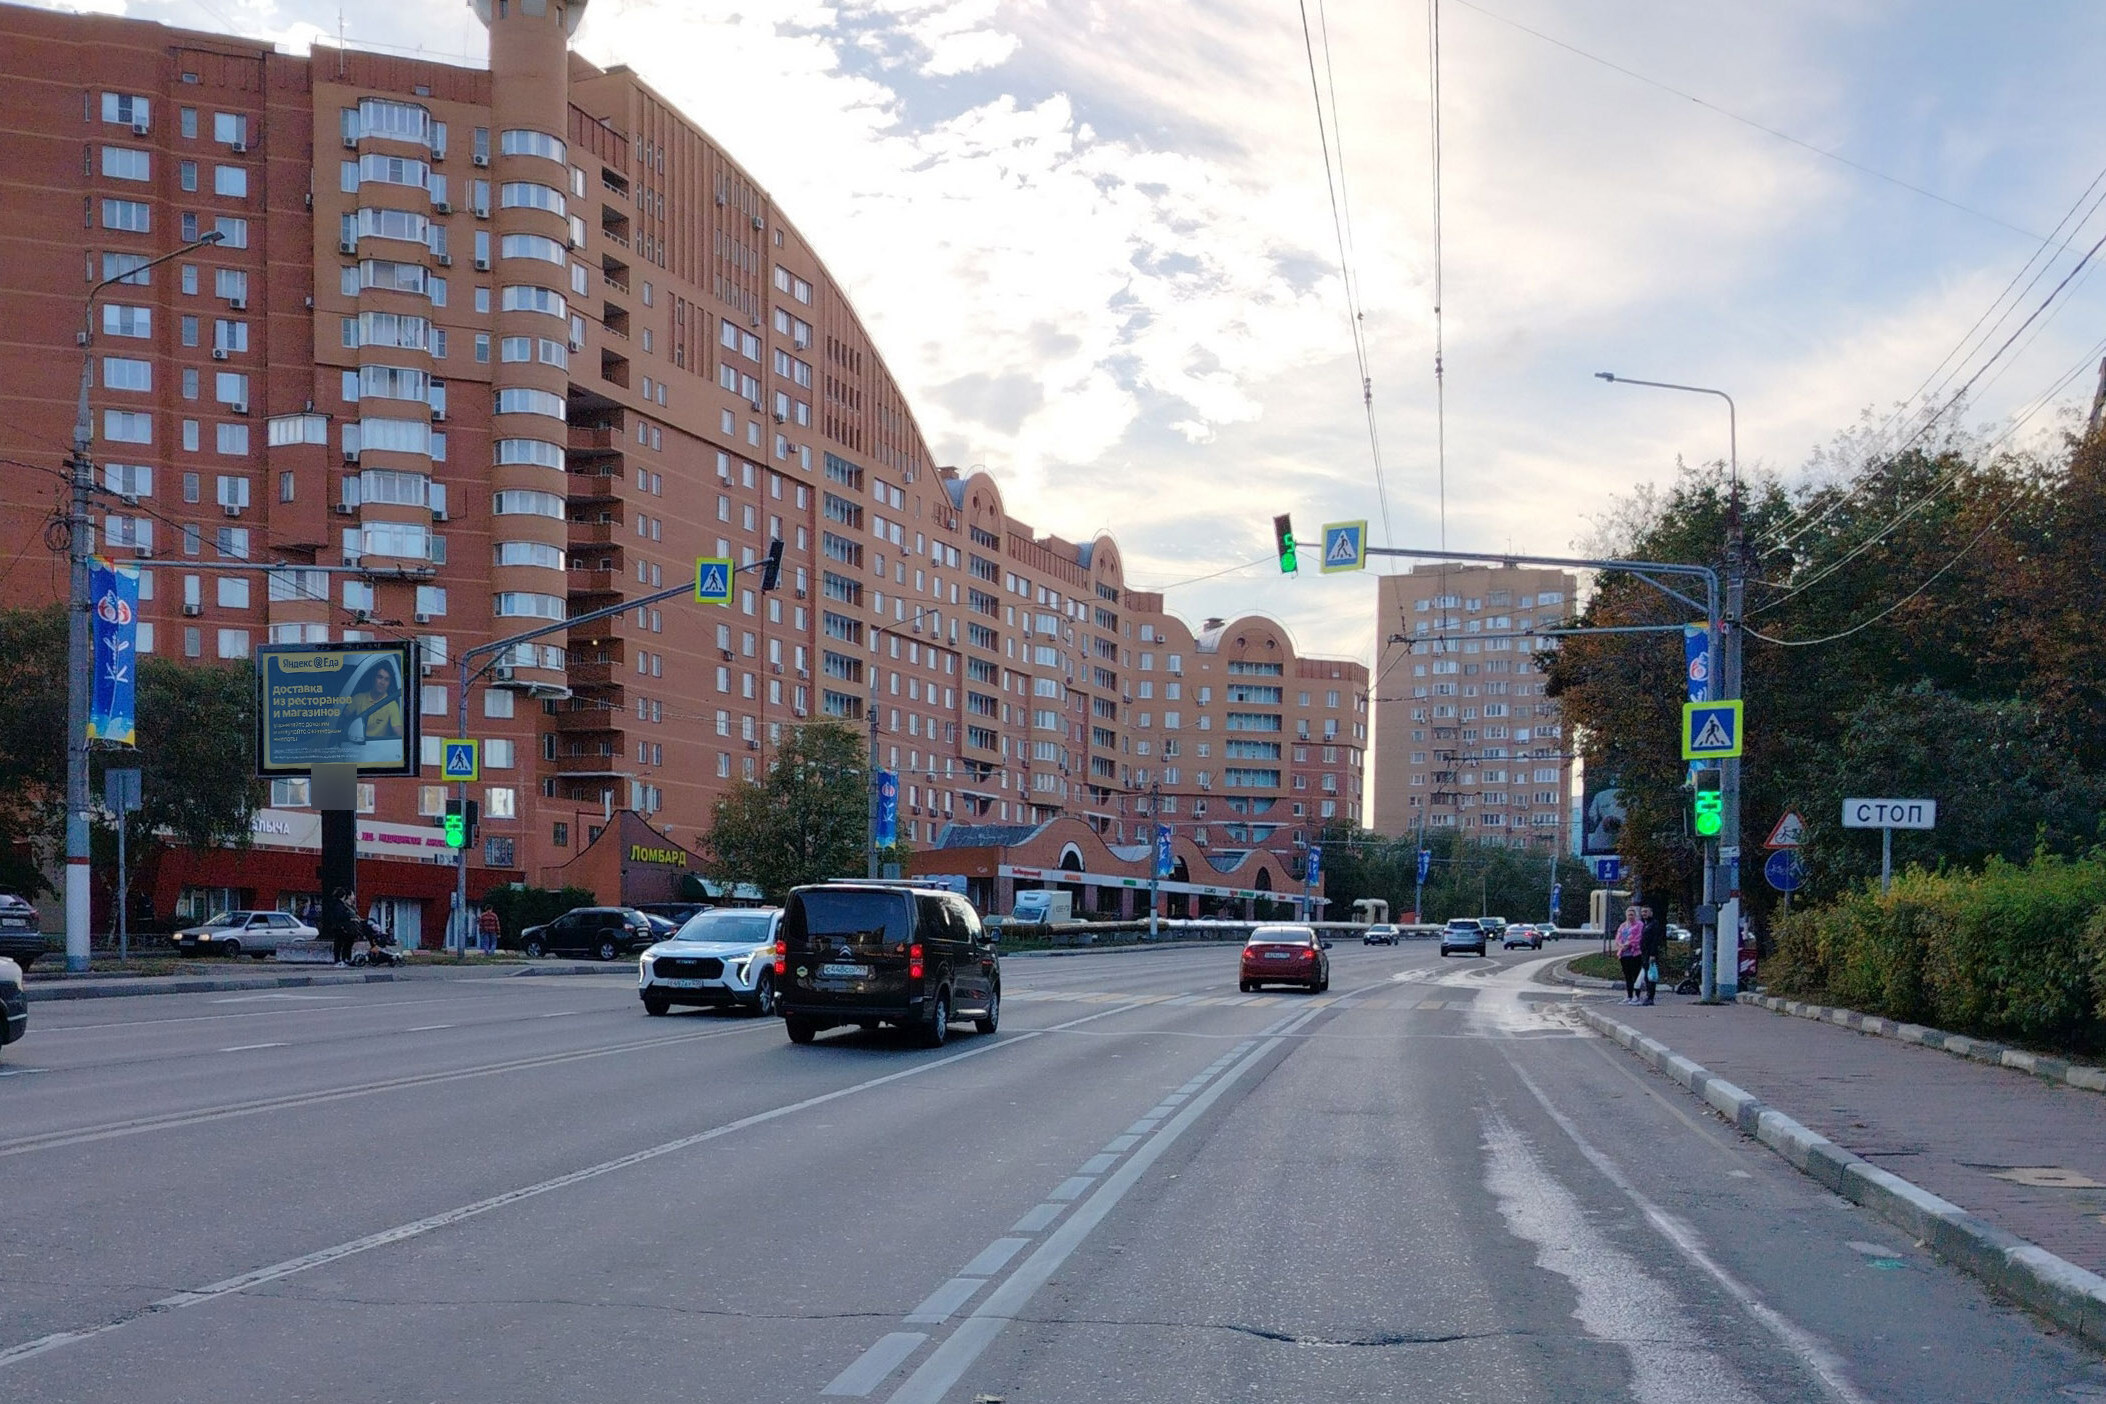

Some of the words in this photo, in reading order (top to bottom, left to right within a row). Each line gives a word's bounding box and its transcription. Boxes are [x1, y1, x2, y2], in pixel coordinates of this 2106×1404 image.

[282, 658, 313, 669] Яндекс
[323, 657, 339, 668] Еда
[273, 684, 323, 696] доставка
[273, 697, 286, 706] из
[287, 695, 352, 707] ресторанов
[273, 709, 281, 718] и
[282, 707, 341, 718] магазинов
[1857, 804, 1922, 823] СТОП
[630, 844, 687, 867] ЛОМБАРД
